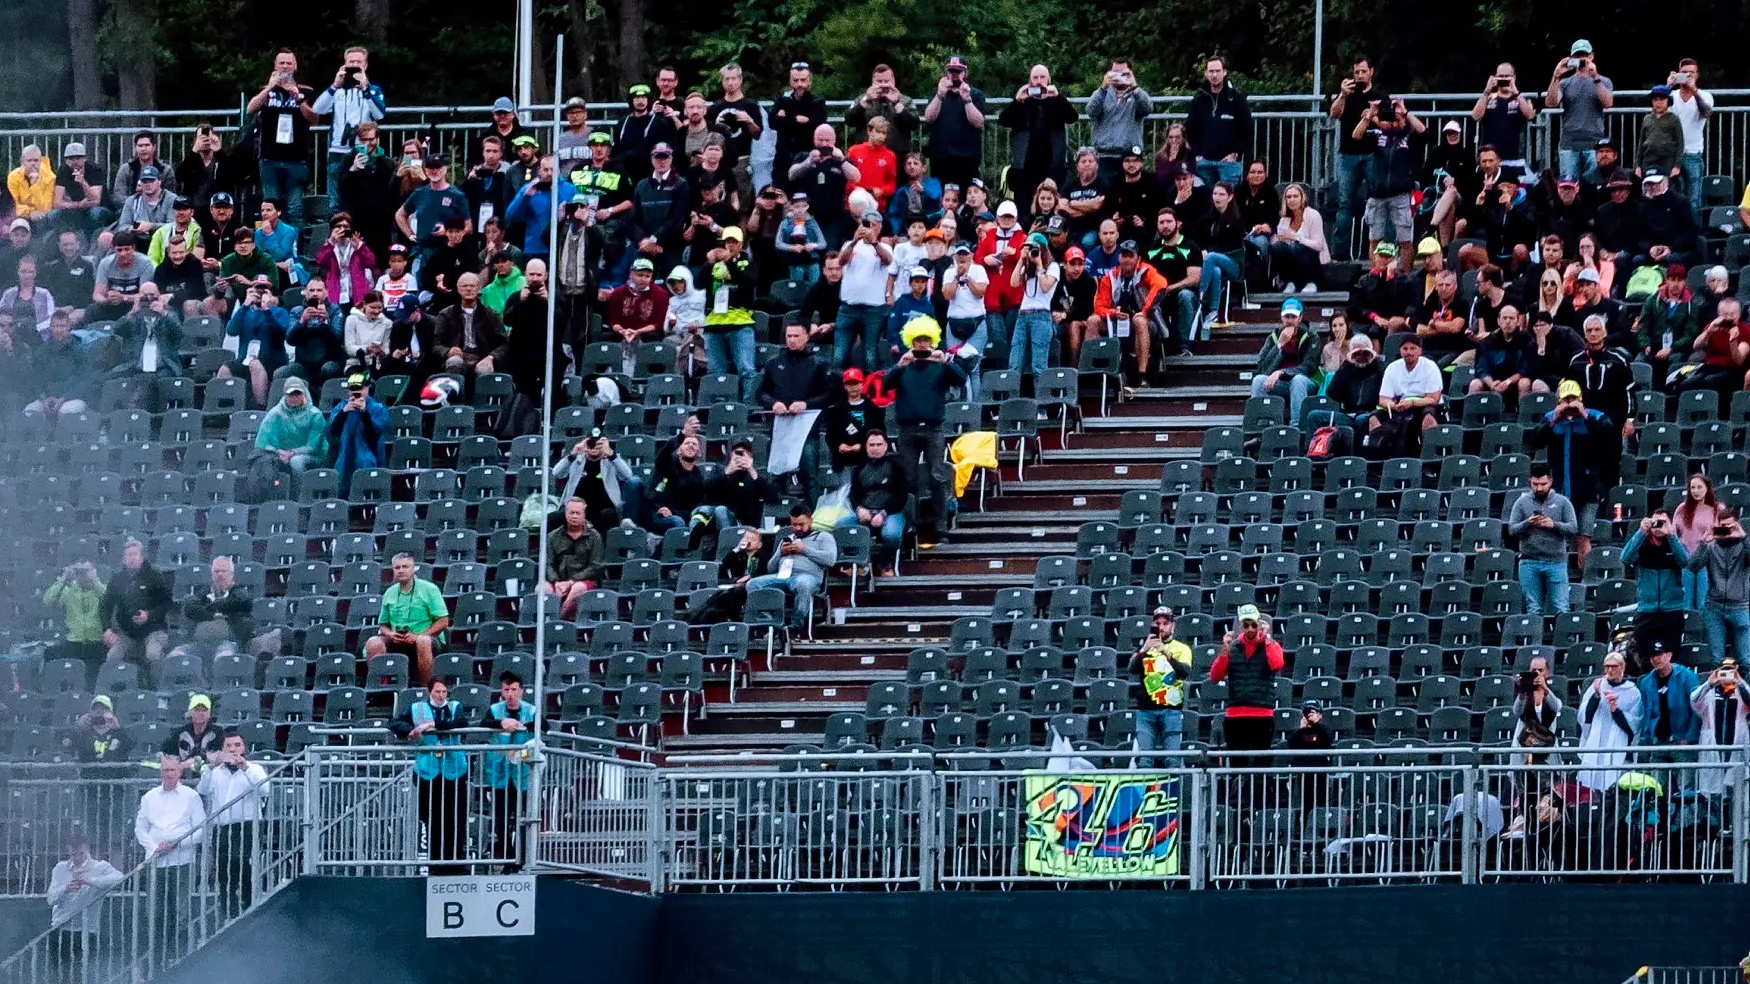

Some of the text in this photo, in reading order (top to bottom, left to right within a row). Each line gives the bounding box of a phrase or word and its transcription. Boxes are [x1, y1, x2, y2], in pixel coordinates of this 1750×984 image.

[431, 883, 478, 894] SECTOR
[485, 881, 531, 893] SECTOR
[443, 902, 464, 929] B
[496, 899, 519, 928] C
